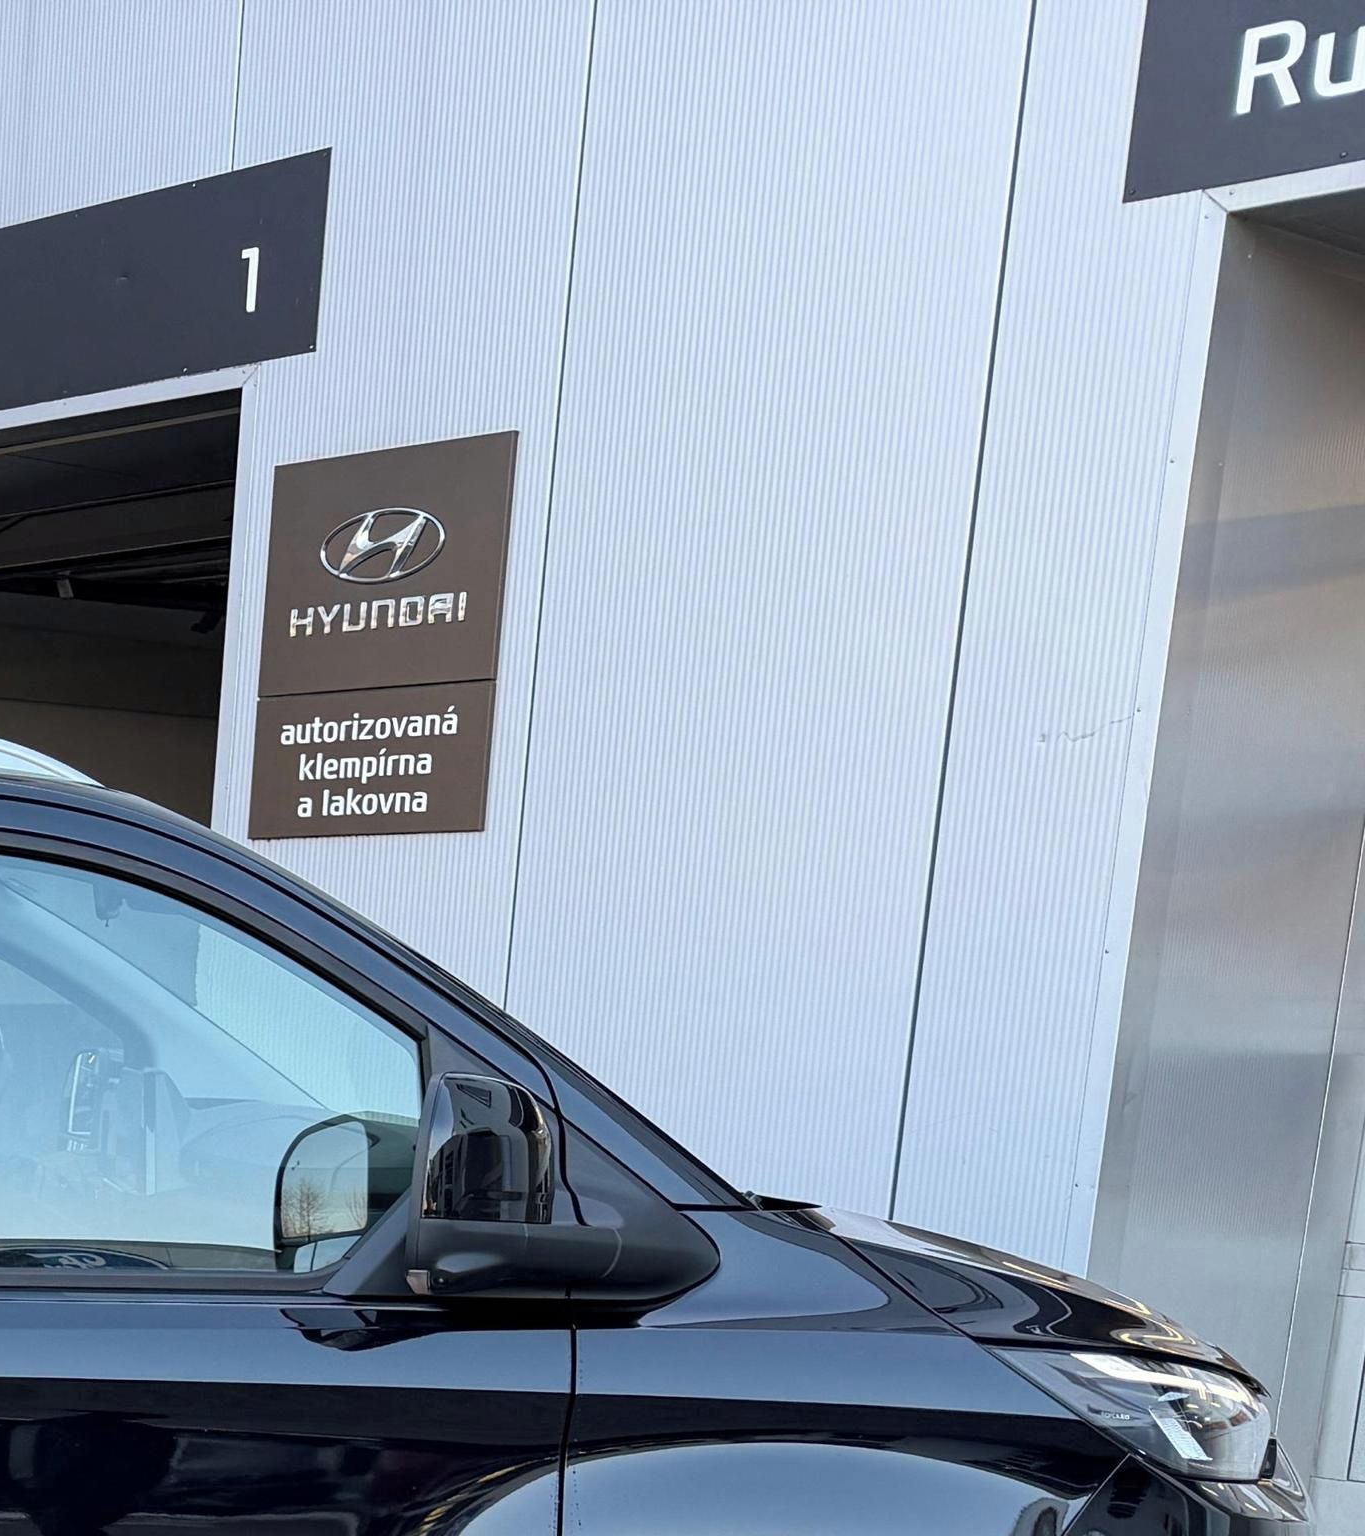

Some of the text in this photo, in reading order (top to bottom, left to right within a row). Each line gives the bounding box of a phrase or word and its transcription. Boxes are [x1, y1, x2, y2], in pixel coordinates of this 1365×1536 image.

[241, 246, 260, 313] 1
[289, 591, 468, 637] HYUNDAI
[280, 705, 459, 745] autorizovaná
[298, 747, 433, 784] klempírna
[297, 787, 428, 818] a lakovna
